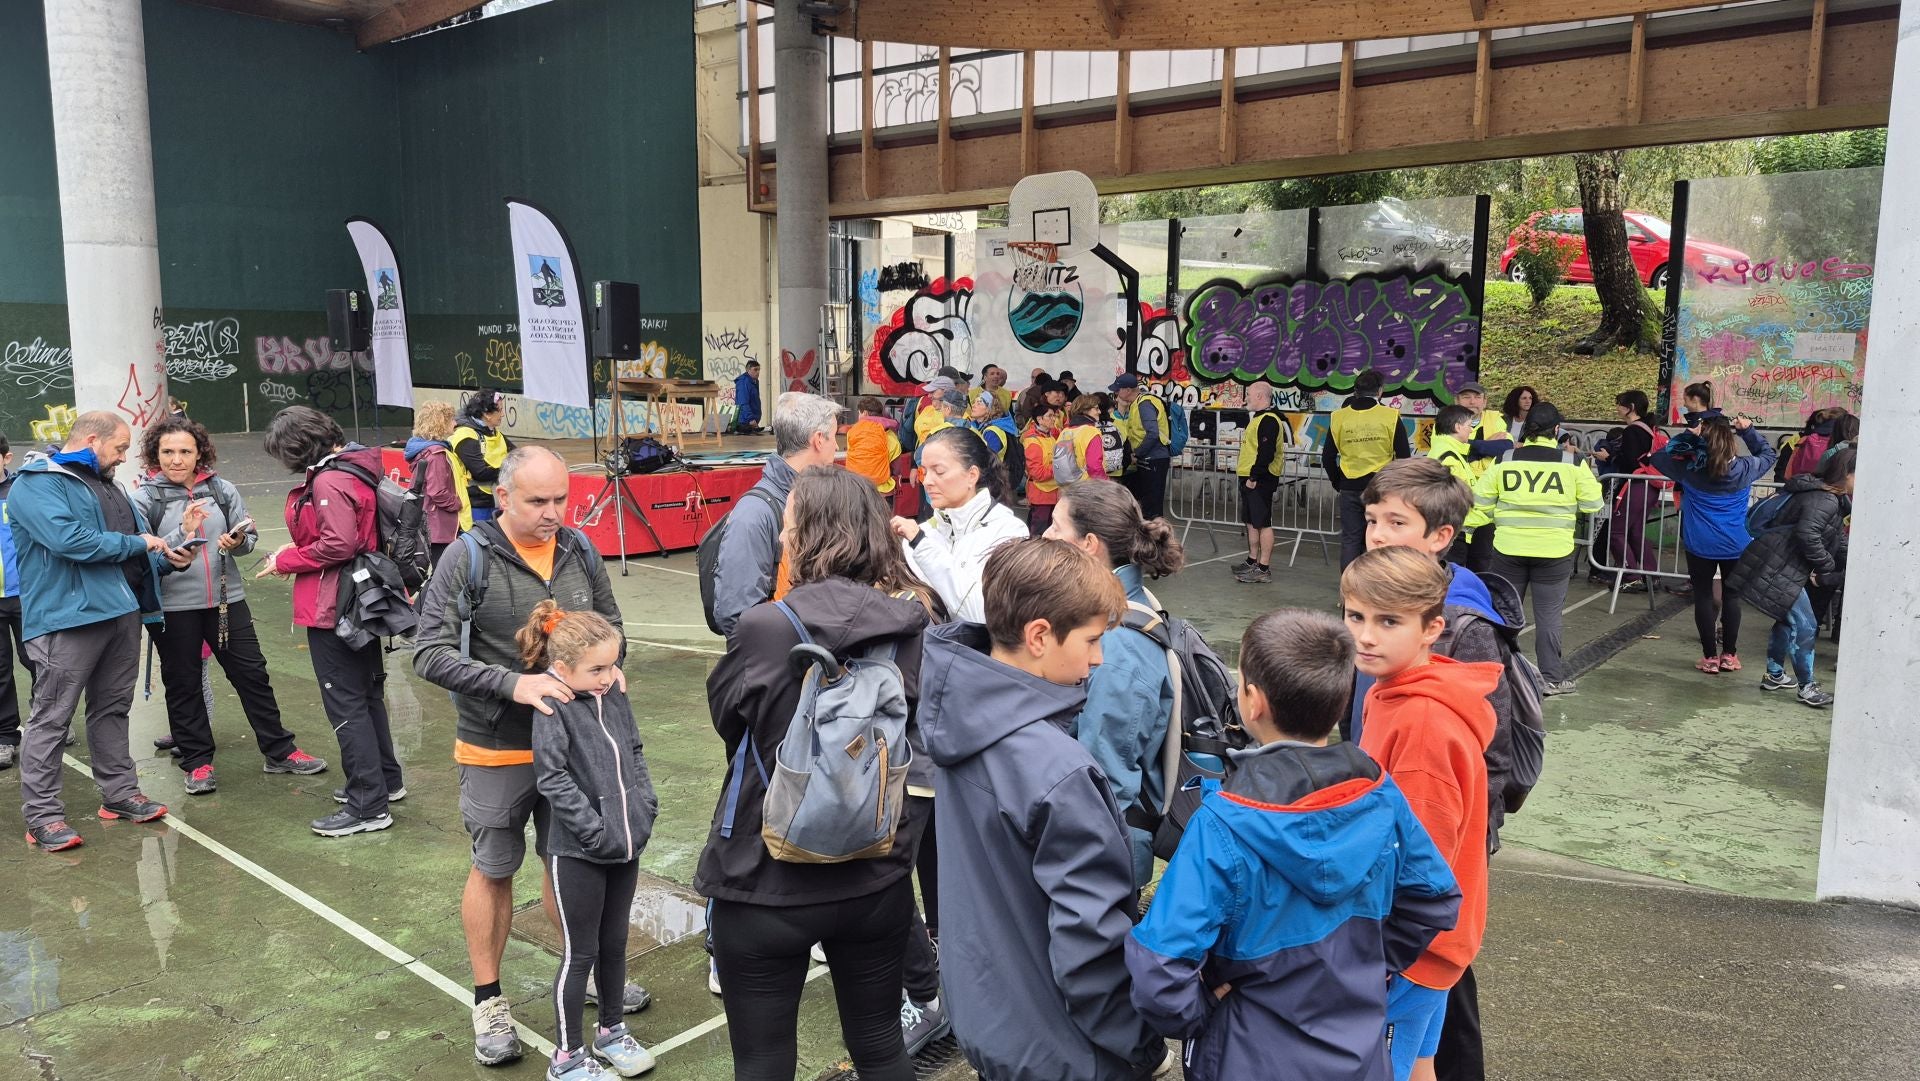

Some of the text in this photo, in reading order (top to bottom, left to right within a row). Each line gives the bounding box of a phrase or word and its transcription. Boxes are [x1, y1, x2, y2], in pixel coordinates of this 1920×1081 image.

[478, 318, 668, 336] MUNDU ZA RAIKI!!
[1503, 470, 1565, 495] DYA
